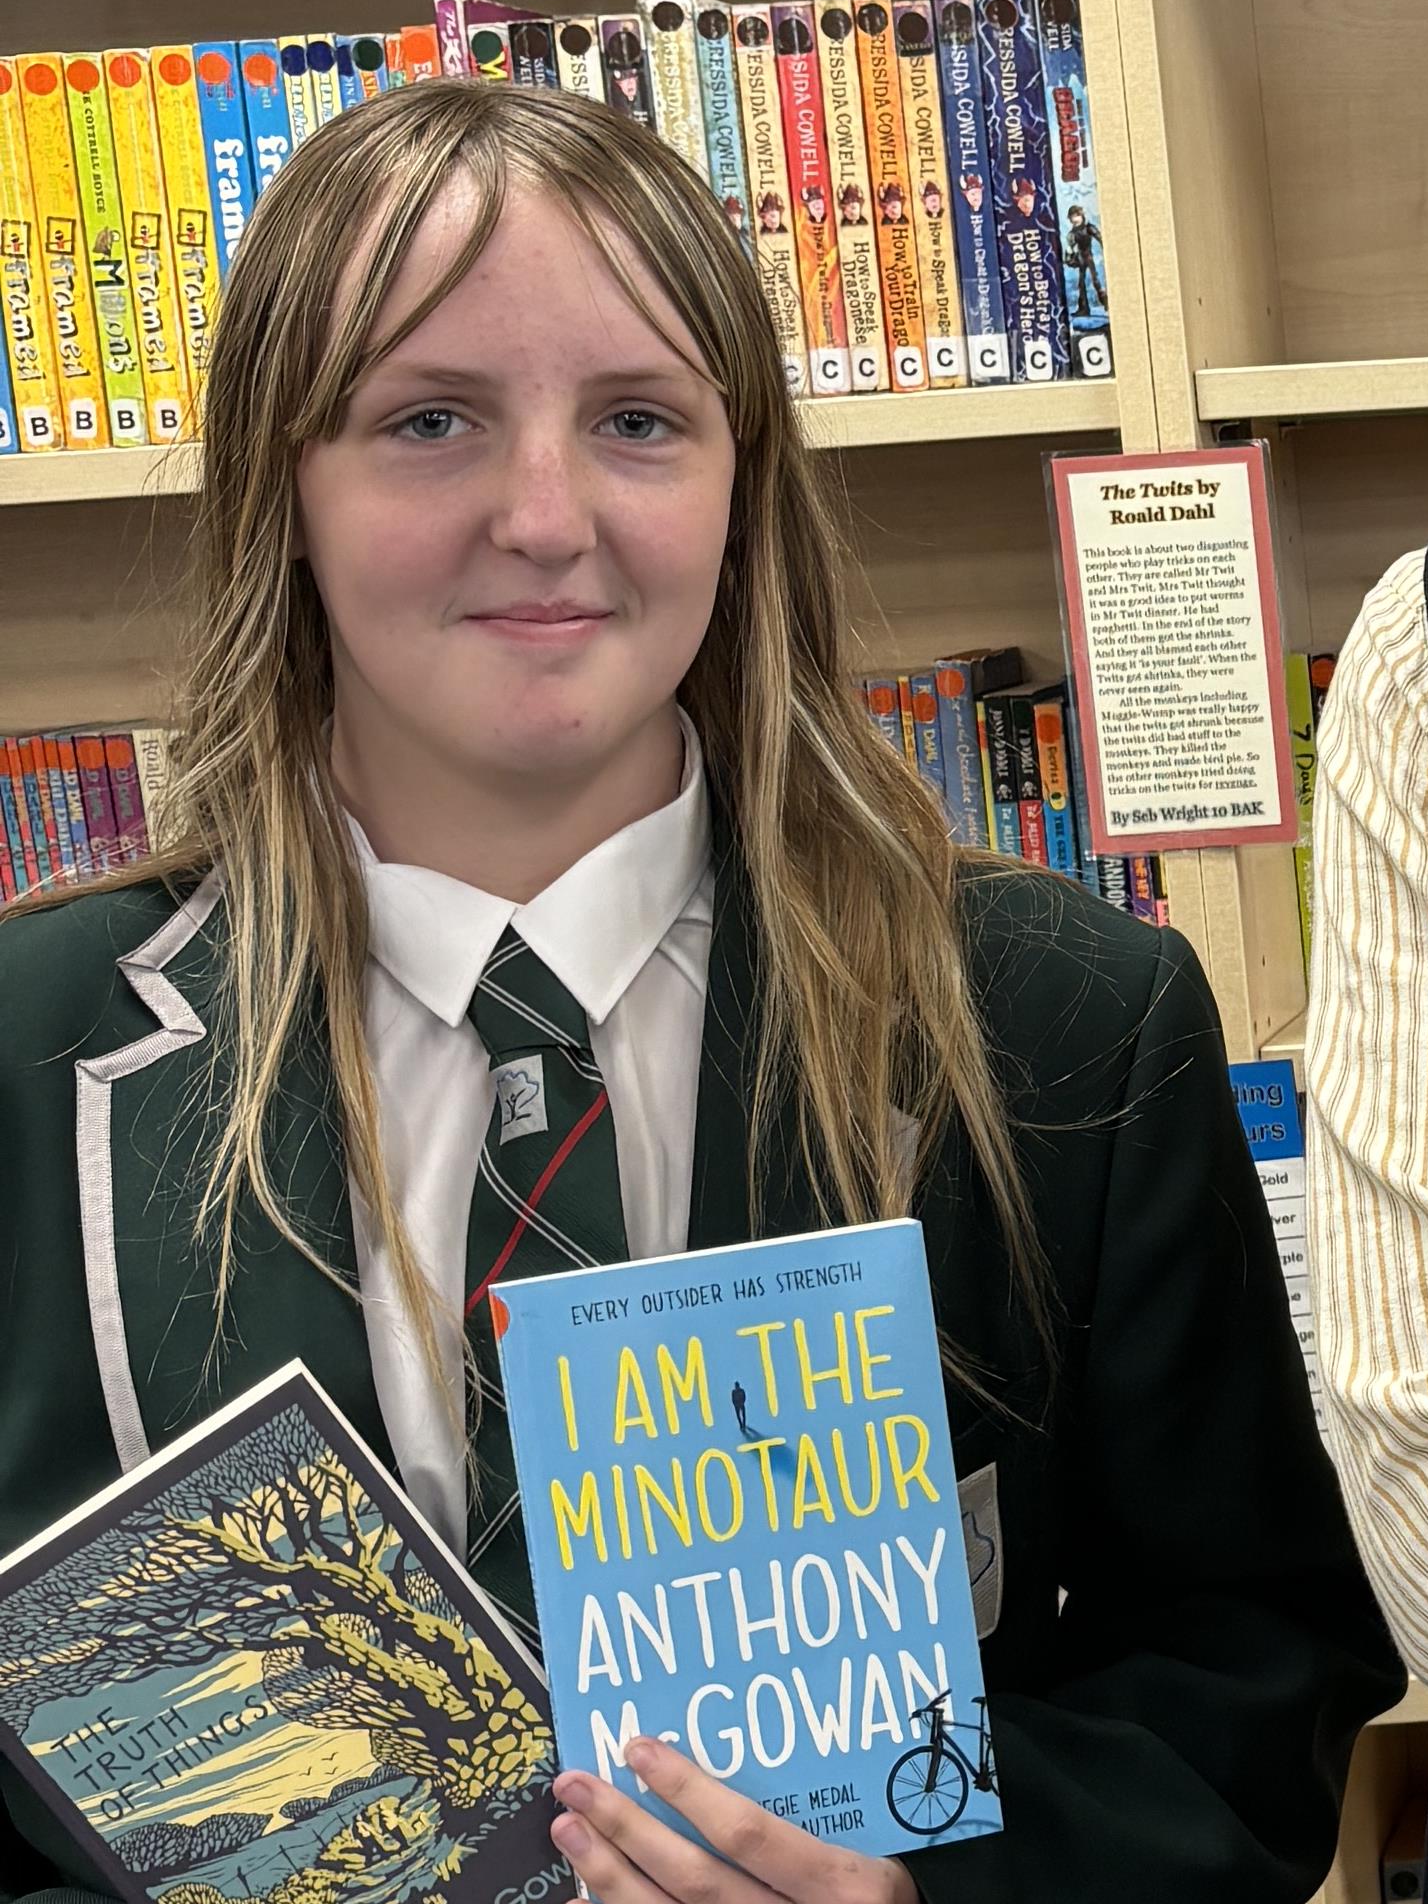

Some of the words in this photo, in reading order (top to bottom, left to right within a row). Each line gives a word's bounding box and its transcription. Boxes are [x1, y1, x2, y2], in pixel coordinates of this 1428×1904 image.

[717, 125, 736, 193] COWELL
[755, 120, 776, 189] COWELL
[798, 109, 818, 181] COWELL
[835, 113, 855, 181] COWELL
[878, 113, 897, 179] COWELL
[913, 107, 936, 178] COWELL
[954, 99, 978, 170] COWELL
[1004, 104, 1025, 172] COWELL
[853, 242, 871, 276] How
[885, 263, 903, 299] Your
[891, 228, 911, 263] How
[903, 280, 920, 320] Train
[1020, 229, 1041, 264] How
[1034, 280, 1051, 331] Betray
[843, 261, 868, 343] Dragonese
[861, 291, 878, 333] Speak
[822, 359, 840, 378] C
[937, 348, 954, 366] C
[1087, 347, 1103, 366] C
[31, 414, 49, 437] B
[160, 409, 178, 428] B
[1100, 484, 1136, 500] The
[1139, 481, 1193, 498] Twits
[1196, 479, 1221, 497] by
[1110, 507, 1166, 525] Roald
[1170, 503, 1215, 521] Dahl
[1084, 548, 1105, 558] This
[1107, 546, 1132, 557] book
[1134, 546, 1142, 554] is
[1145, 544, 1173, 554] about
[1176, 544, 1194, 552] two
[1197, 539, 1248, 552] disgusting
[1085, 561, 1118, 572] people
[1120, 559, 1140, 568] who
[1144, 557, 1164, 568] play
[1167, 555, 1195, 566] tricks
[1212, 553, 1236, 562] each
[1118, 572, 1142, 582] They
[1145, 571, 1161, 579] are
[1163, 568, 1192, 578] called
[1195, 567, 1209, 576] Mr
[1212, 566, 1234, 575] Twit
[1088, 586, 1106, 596] and
[1109, 586, 1128, 594] Mrs
[1159, 582, 1179, 592] Mrs
[1181, 580, 1203, 589] Twit
[1206, 577, 1245, 589] thought
[1112, 810, 1130, 827] By
[1132, 809, 1157, 824] Seb
[1160, 805, 1208, 825] Wright
[1213, 807, 1227, 817] 10
[1231, 801, 1264, 816] BAK
[571, 1297, 630, 1326] EVERY
[641, 1284, 723, 1314] OUTSIDER
[735, 1277, 767, 1300] HAS
[775, 1261, 863, 1295] STRENGTH
[557, 1355, 579, 1451] I
[614, 1335, 714, 1445] AM
[736, 1305, 904, 1418] THE
[550, 1414, 940, 1571] MINOTAUR
[577, 1527, 948, 1694] ANTHONY
[49, 1706, 133, 1761] THE
[73, 1706, 186, 1790] TRUTH
[100, 1778, 139, 1821] OF
[134, 1694, 270, 1789] THINGS
[808, 1783, 862, 1807] MEDAL
